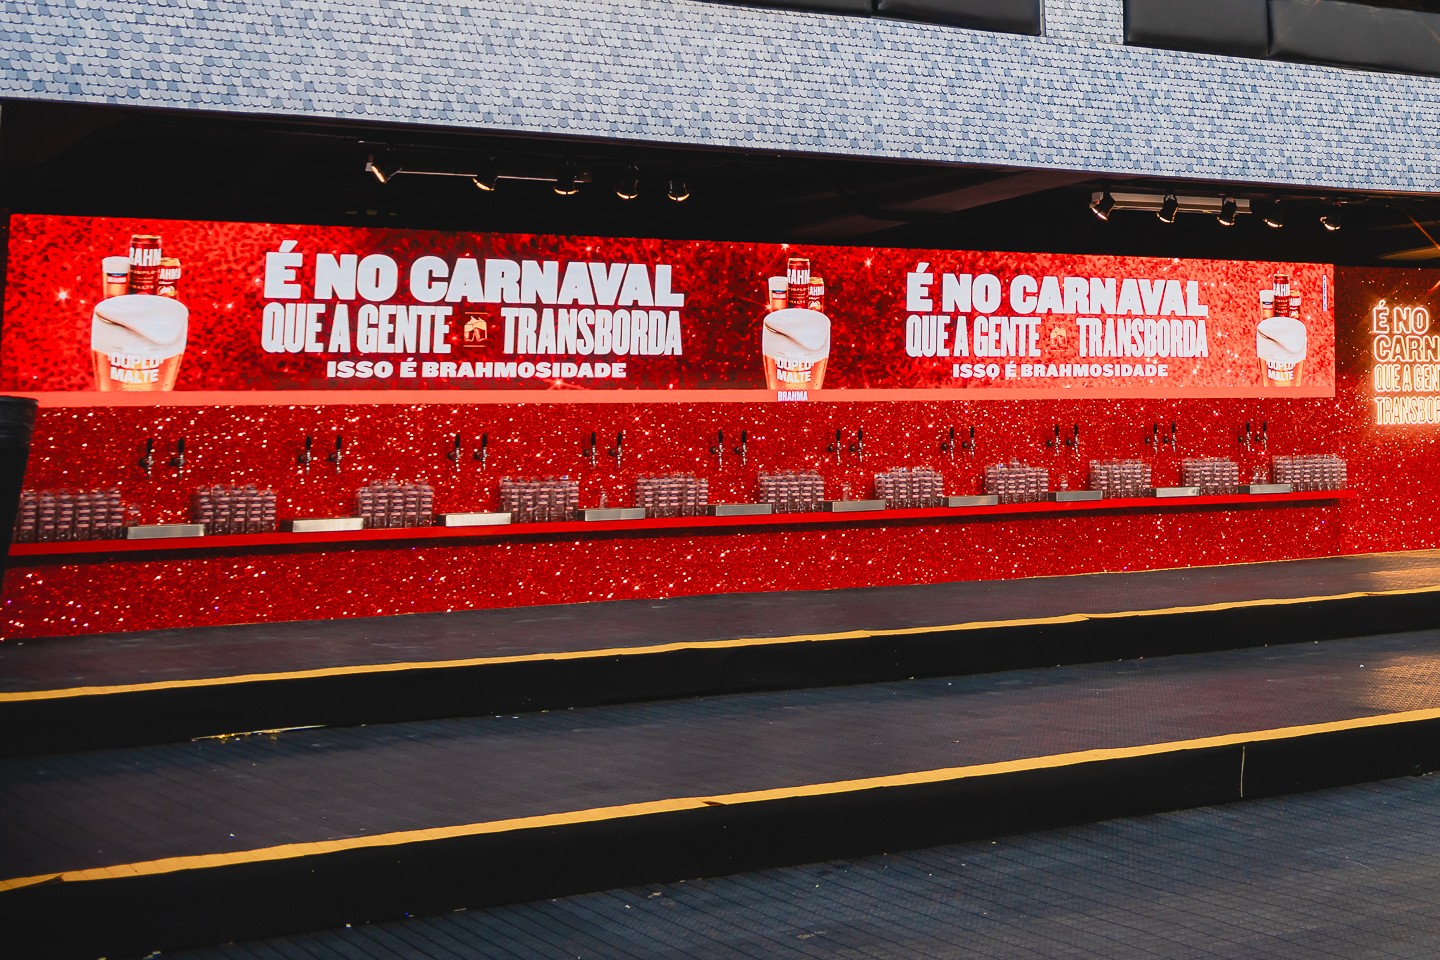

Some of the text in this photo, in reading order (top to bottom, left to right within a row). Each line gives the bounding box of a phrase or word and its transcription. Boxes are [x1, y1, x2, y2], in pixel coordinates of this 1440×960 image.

[264, 240, 685, 307] É NO CARNAVAL
[906, 262, 1209, 317] É NO CARNAVAL
[261, 302, 682, 356] QUE A GENTE TRANSBORDA
[1373, 299, 1429, 335] É NO
[905, 314, 1209, 358] QUE A GENTE TRANSBORDA
[110, 367, 160, 383] MALTE
[327, 357, 627, 378] ISSO É BRAHMOSIDADE
[777, 369, 812, 384] MALTE
[952, 360, 1169, 379] ISSO É BRAHMOSIDADE
[1268, 369, 1294, 381] MALTE
[1374, 364, 1401, 392] QUE
[1402, 364, 1412, 392] A
[777, 391, 808, 402] BRAHMA
